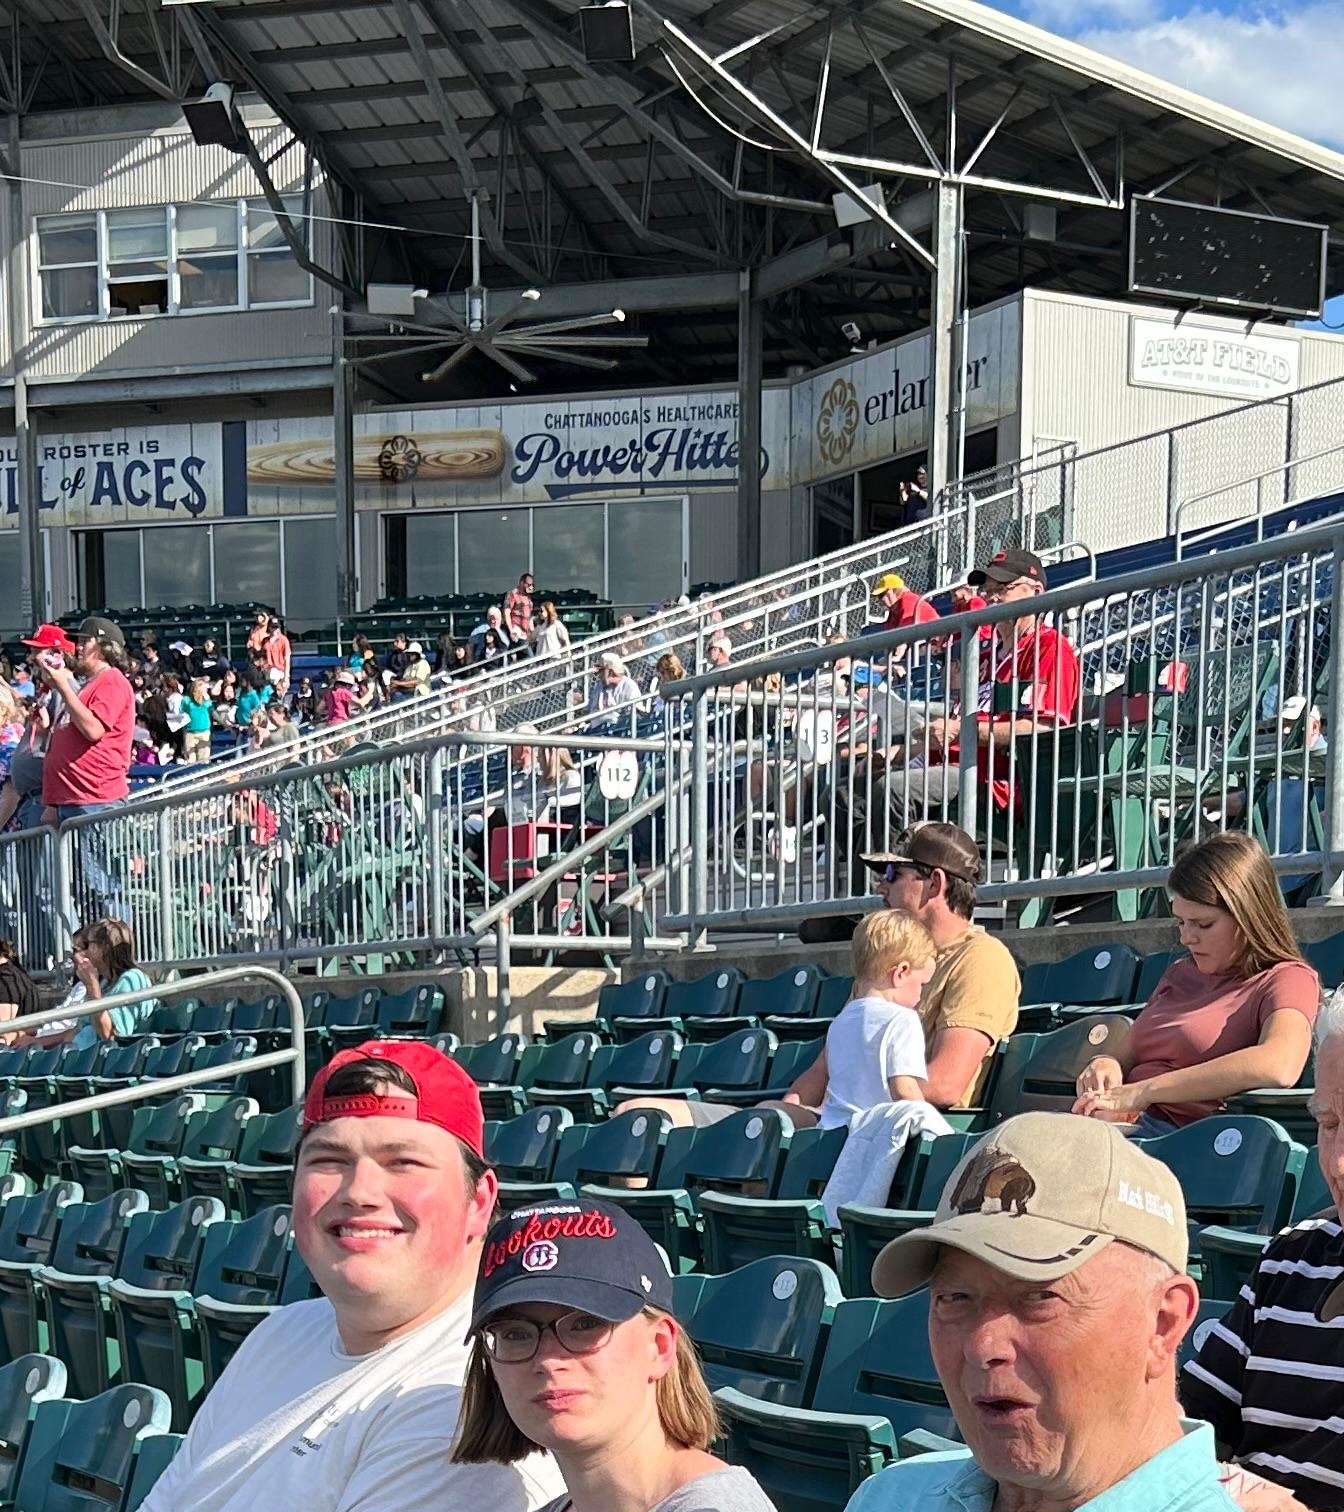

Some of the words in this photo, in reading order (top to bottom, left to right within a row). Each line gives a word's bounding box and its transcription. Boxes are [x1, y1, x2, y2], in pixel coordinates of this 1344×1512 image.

[1142, 338, 1207, 368] AT&T
[1213, 341, 1290, 384] FIELD
[657, 403, 739, 423] HEALTHCARE
[44, 443, 129, 461] ROSTER
[140, 440, 160, 454] IS
[510, 433, 646, 484] Power
[60, 467, 86, 499] of
[90, 456, 207, 516] ACES
[607, 767, 631, 782] 112
[484, 1200, 617, 1278] Lookouts
